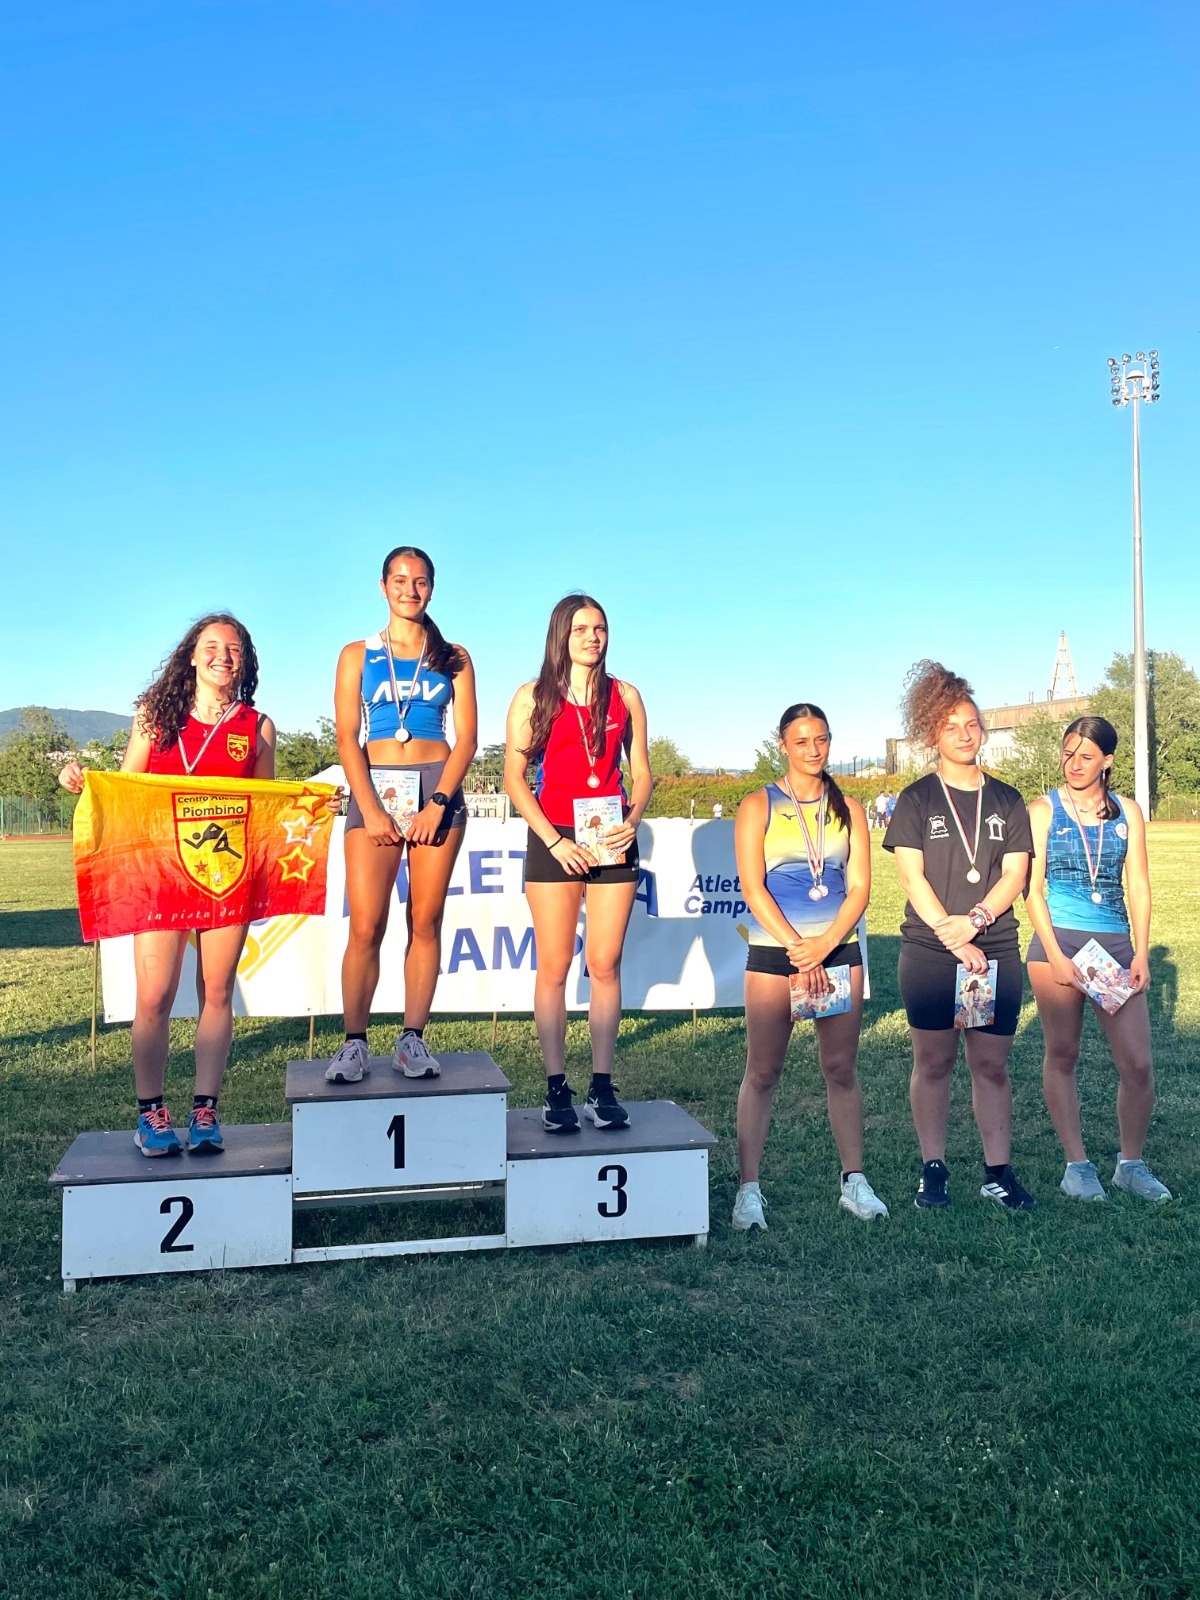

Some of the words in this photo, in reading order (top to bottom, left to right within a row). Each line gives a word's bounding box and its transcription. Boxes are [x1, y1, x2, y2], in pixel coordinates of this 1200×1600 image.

[183, 805, 245, 817] Piombino
[688, 875, 742, 893] Atlet
[386, 1114, 405, 1170] 1
[597, 1164, 628, 1218] 3
[159, 1196, 194, 1254] 2
